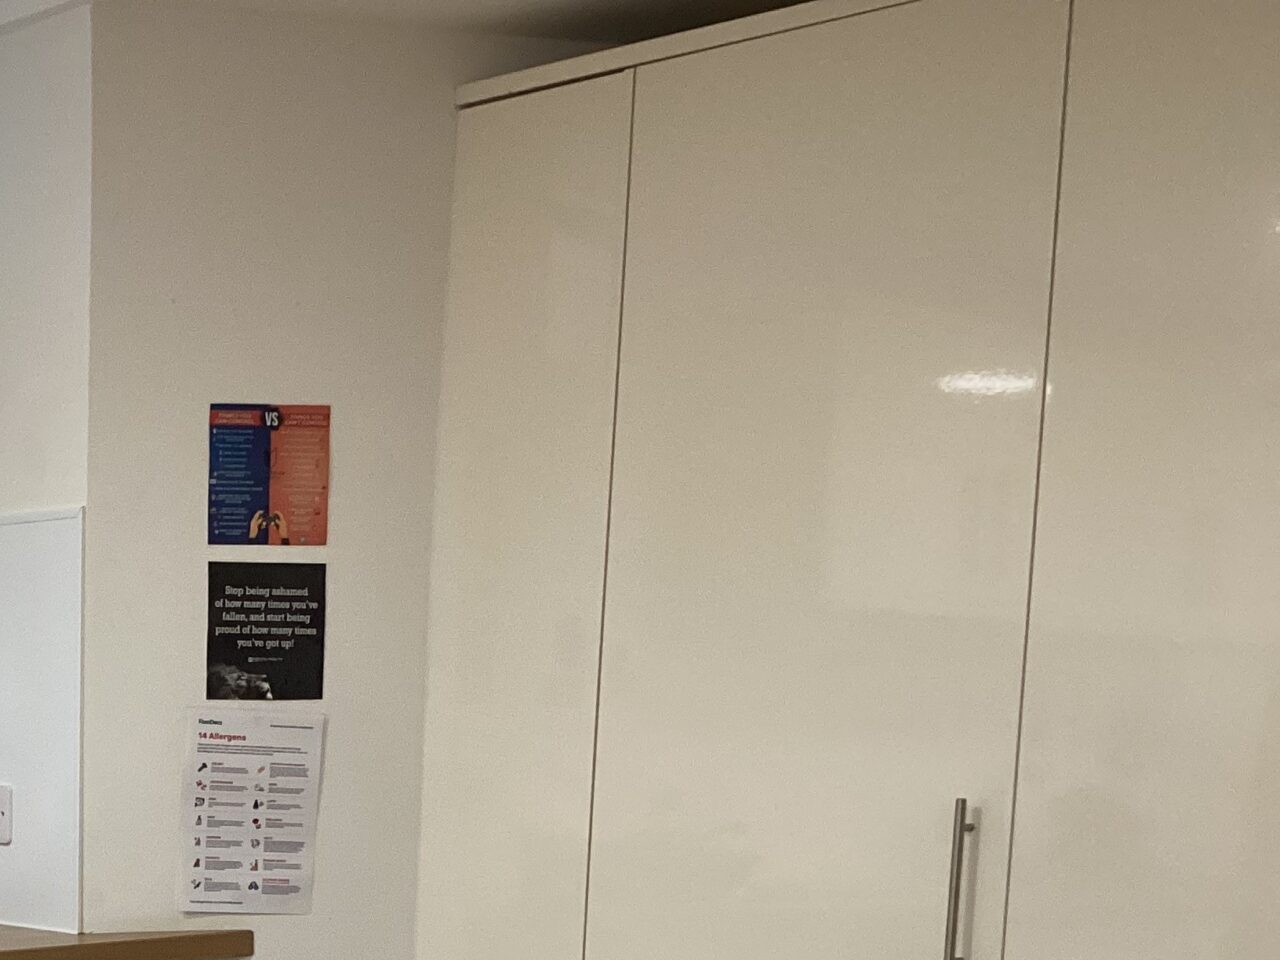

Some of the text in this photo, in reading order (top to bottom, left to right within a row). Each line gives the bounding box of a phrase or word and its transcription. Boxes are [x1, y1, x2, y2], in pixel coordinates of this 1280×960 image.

[264, 411, 279, 427] VS
[225, 585, 308, 597] Stop being ashamed
[214, 598, 318, 611] of how many times you've
[249, 612, 265, 622] and
[266, 613, 285, 622] start
[286, 612, 311, 624] being
[215, 625, 317, 636] proud of how many times
[237, 638, 295, 650] you've got up!
[208, 732, 246, 742] Allergens
